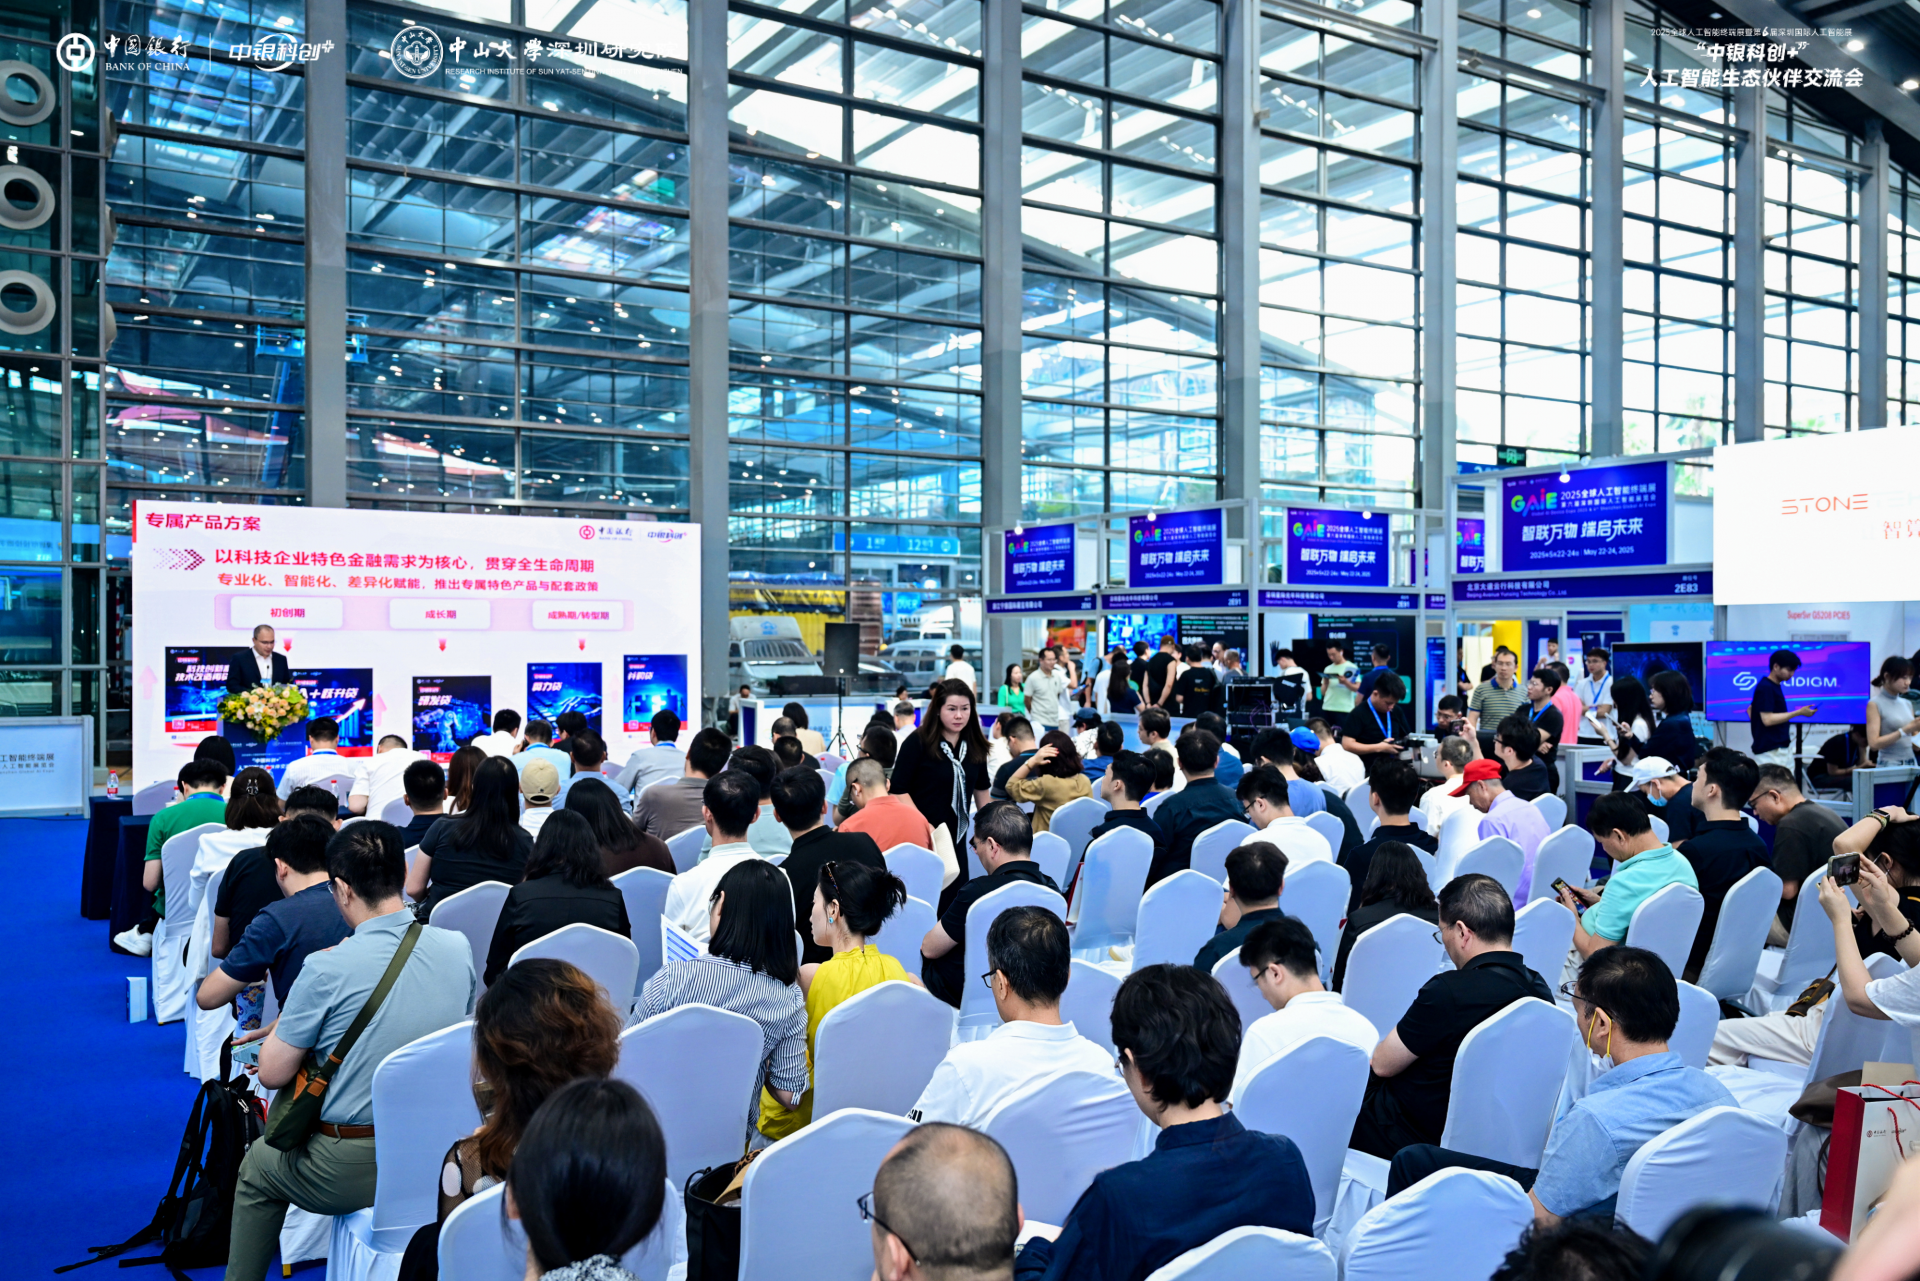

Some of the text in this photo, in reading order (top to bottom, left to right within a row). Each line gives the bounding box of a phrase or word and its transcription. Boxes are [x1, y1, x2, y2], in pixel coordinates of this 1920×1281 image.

[1560, 482, 1656, 500] 2025全球人工智能终端展
[145, 513, 261, 531] 专属产品方案
[1522, 517, 1644, 546] 智联万物 端启未来
[1300, 548, 1376, 567] 智联万物 端启未来
[1583, 548, 1598, 557] May
[1598, 547, 1618, 556] 22-24,
[1618, 546, 1635, 554] 2025
[1140, 549, 1210, 569] 智联万物 端启未来
[1674, 583, 1699, 594] 2E83
[270, 608, 306, 618] 初创期
[425, 610, 457, 620] 成长期
[547, 611, 610, 620] 成熟期/转型期
